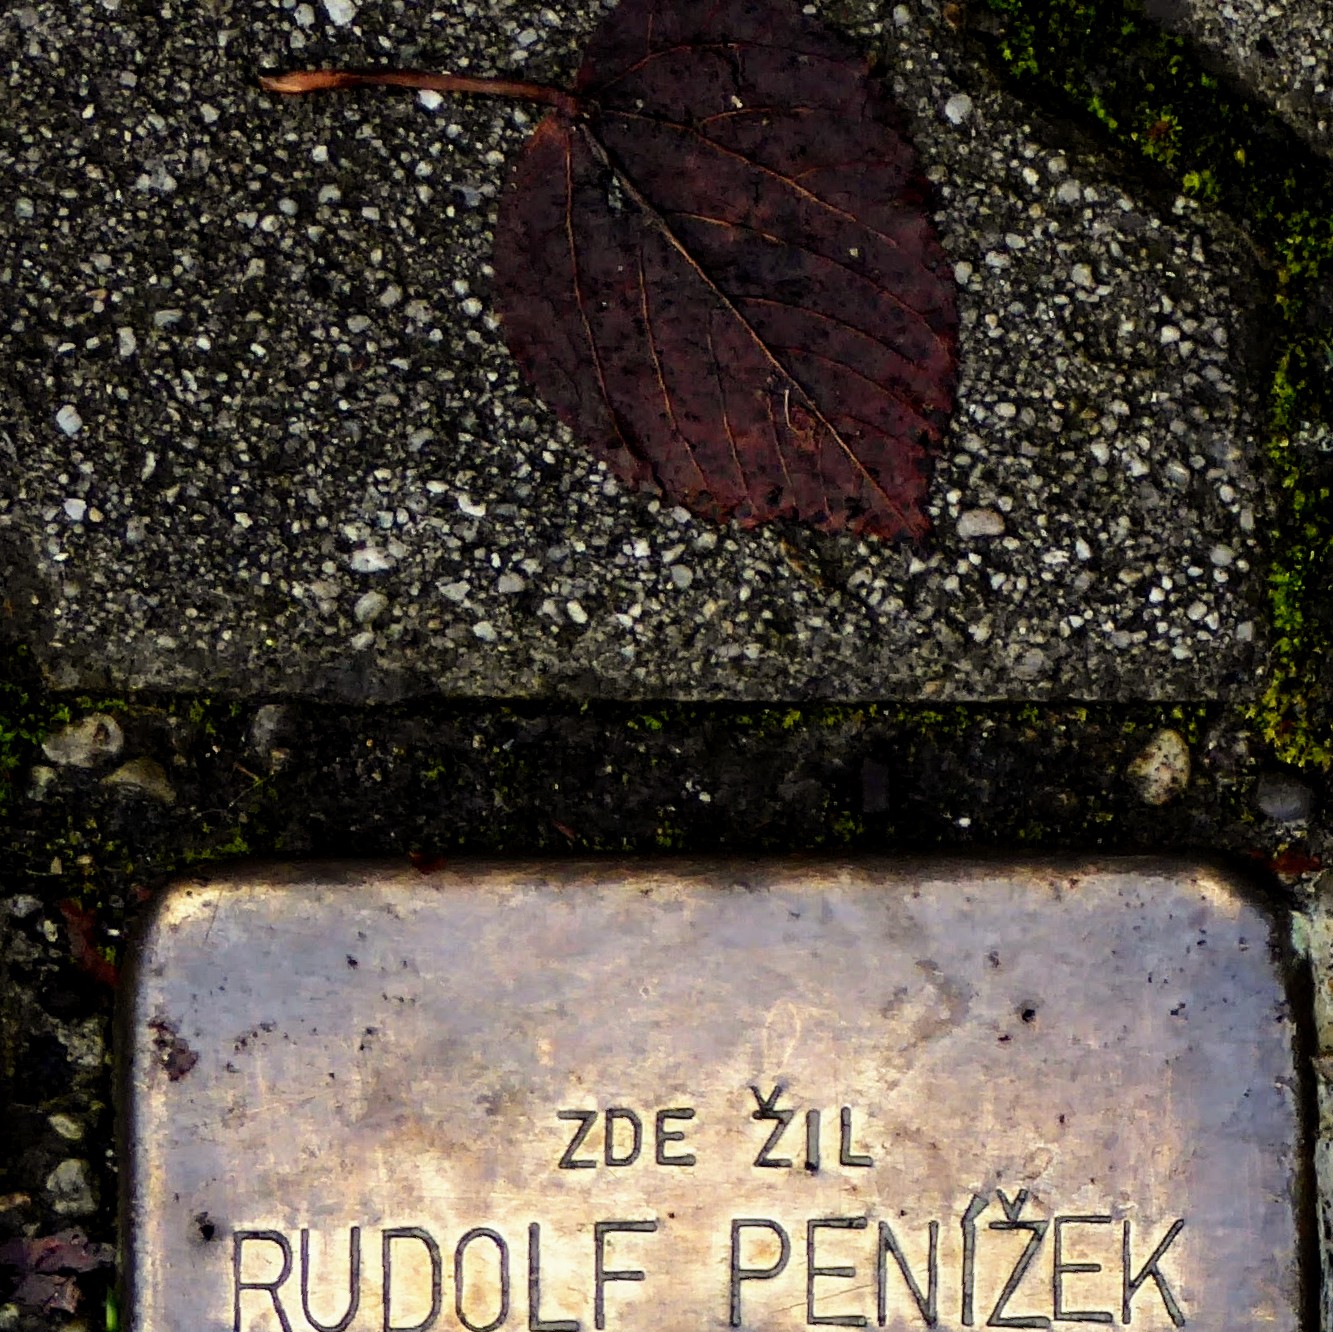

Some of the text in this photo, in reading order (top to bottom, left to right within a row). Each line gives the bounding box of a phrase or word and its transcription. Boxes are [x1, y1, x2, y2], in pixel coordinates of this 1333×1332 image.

[557, 1082, 876, 1176] ZDE ŽIL
[729, 1187, 1189, 1331] PENÍŽEK
